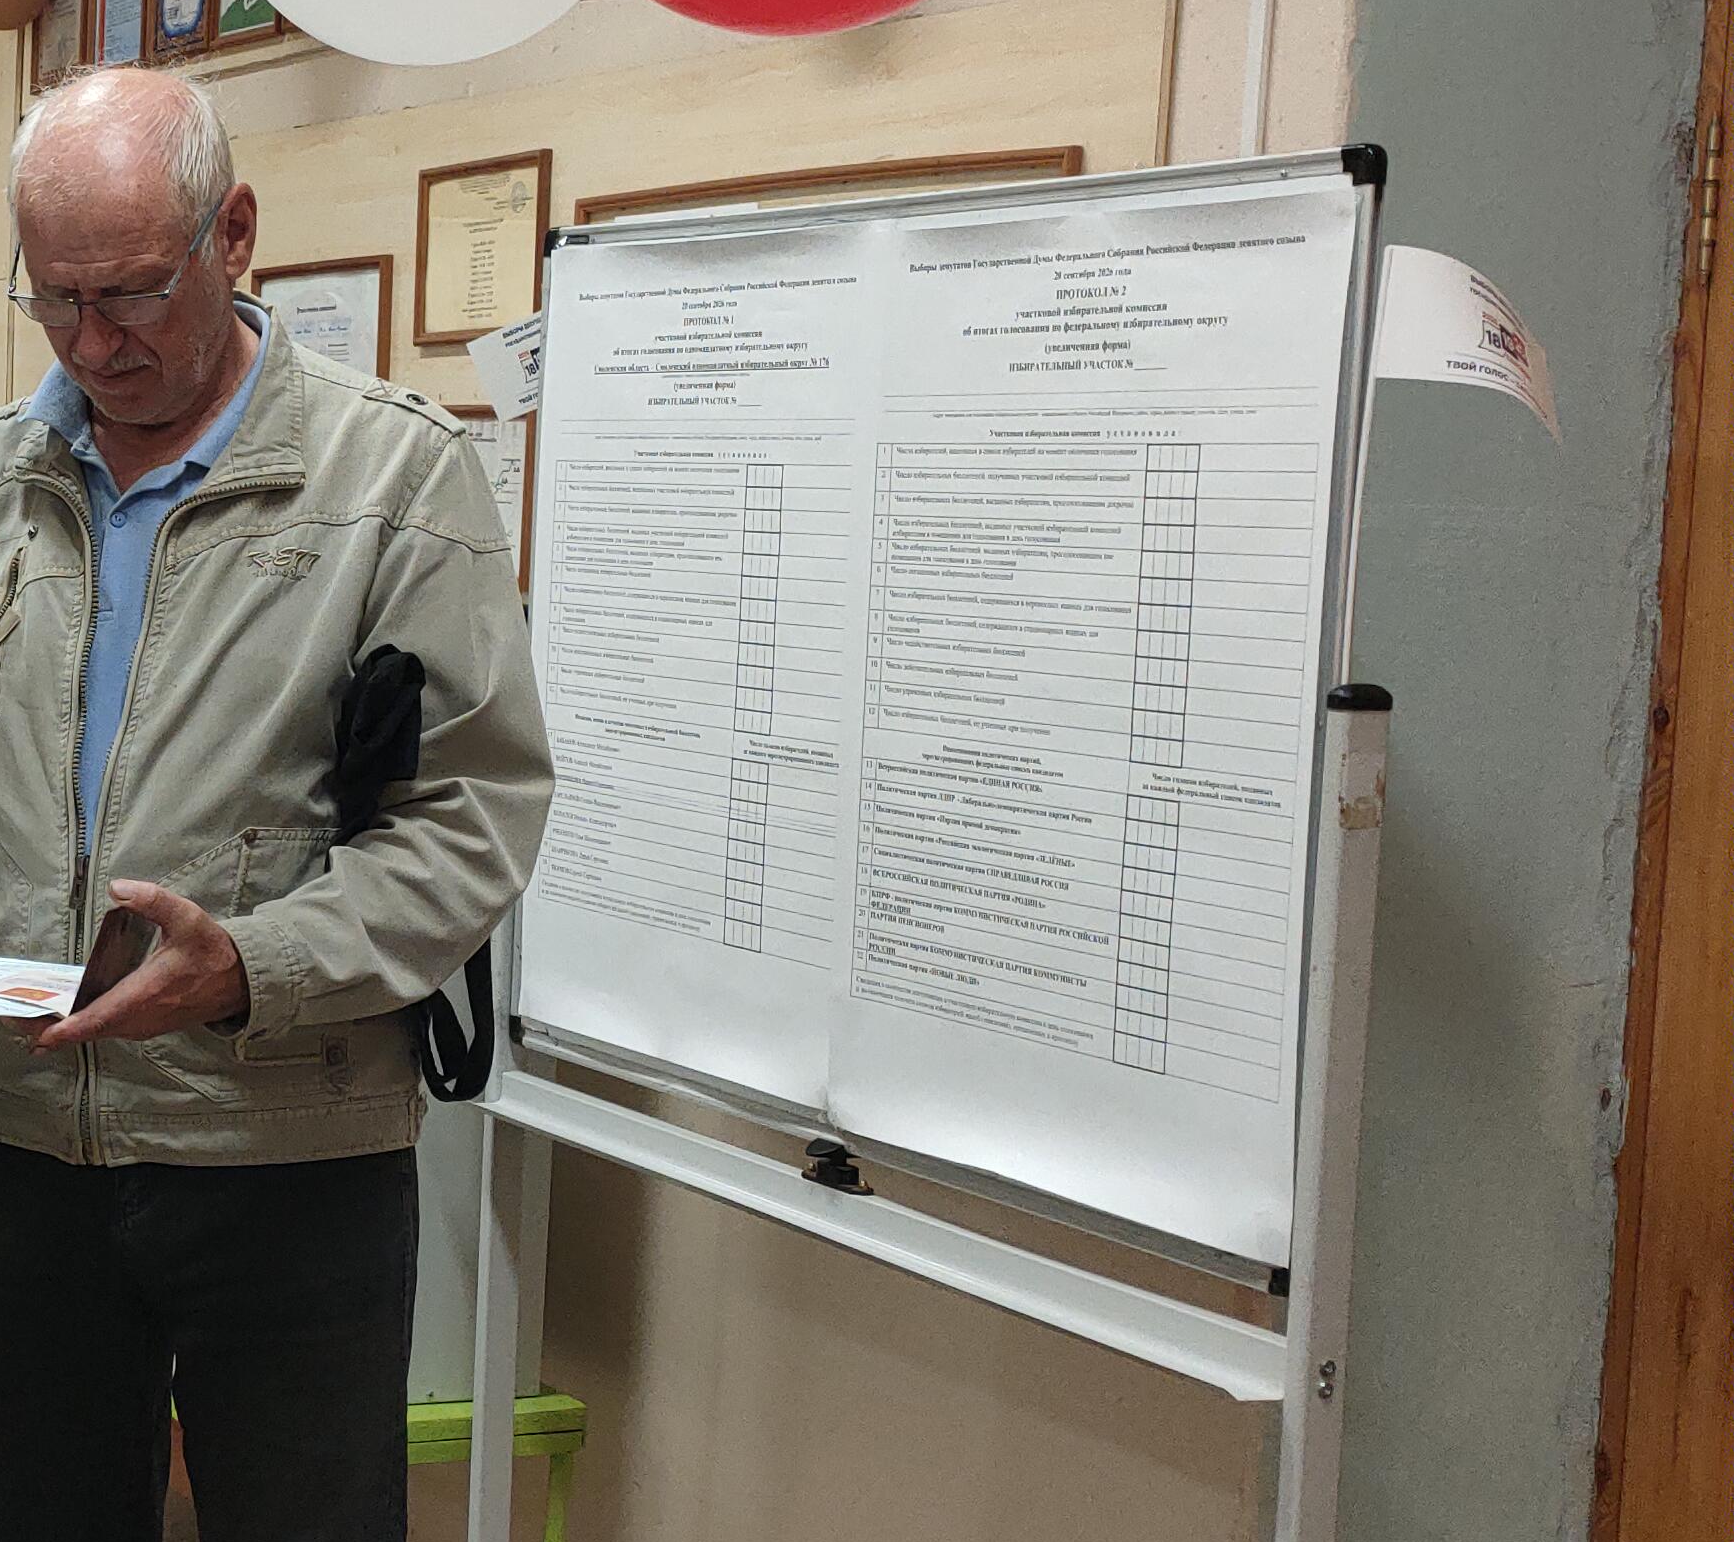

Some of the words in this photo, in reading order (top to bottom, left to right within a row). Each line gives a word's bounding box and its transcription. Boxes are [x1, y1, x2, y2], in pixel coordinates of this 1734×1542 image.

[1107, 247, 1144, 259] Собрания
[1146, 243, 1190, 256] Российской
[1192, 241, 1236, 252] Федерации
[1063, 269, 1095, 281] сентября
[1115, 268, 1132, 276] года
[1056, 288, 1108, 300] ПРОТОКОЛ
[1109, 286, 1119, 296] №
[1121, 286, 1127, 296] 2
[1015, 307, 1061, 321] участковой
[1063, 304, 1123, 318] избирательной
[1125, 303, 1167, 313] комиссии
[683, 317, 721, 327] ПРОТОКОЛ
[963, 326, 972, 336] об
[973, 326, 998, 335] итогах
[1000, 325, 1050, 334] голосования
[1052, 324, 1061, 332] по
[1064, 320, 1120, 334] федеральному
[1123, 318, 1193, 330] избирательному
[1197, 316, 1228, 327] округу
[1045, 342, 1099, 354] (увеличенная
[1102, 339, 1130, 353] форма)
[1486, 330, 1501, 349] 18
[525, 363, 537, 376] 18
[1009, 360, 1081, 371] ИЗБИРАТЕЛЬНЫЙ
[1083, 359, 1124, 370] УЧАСТОК
[1446, 360, 1476, 372] ТВОЙ
[1479, 365, 1508, 381] ГОЛОС
[984, 890, 1010, 902] ПАРТИЯ
[1030, 923, 1058, 936] ПАРТИЯ
[1059, 929, 1110, 945] РОССИЙСКОЙ
